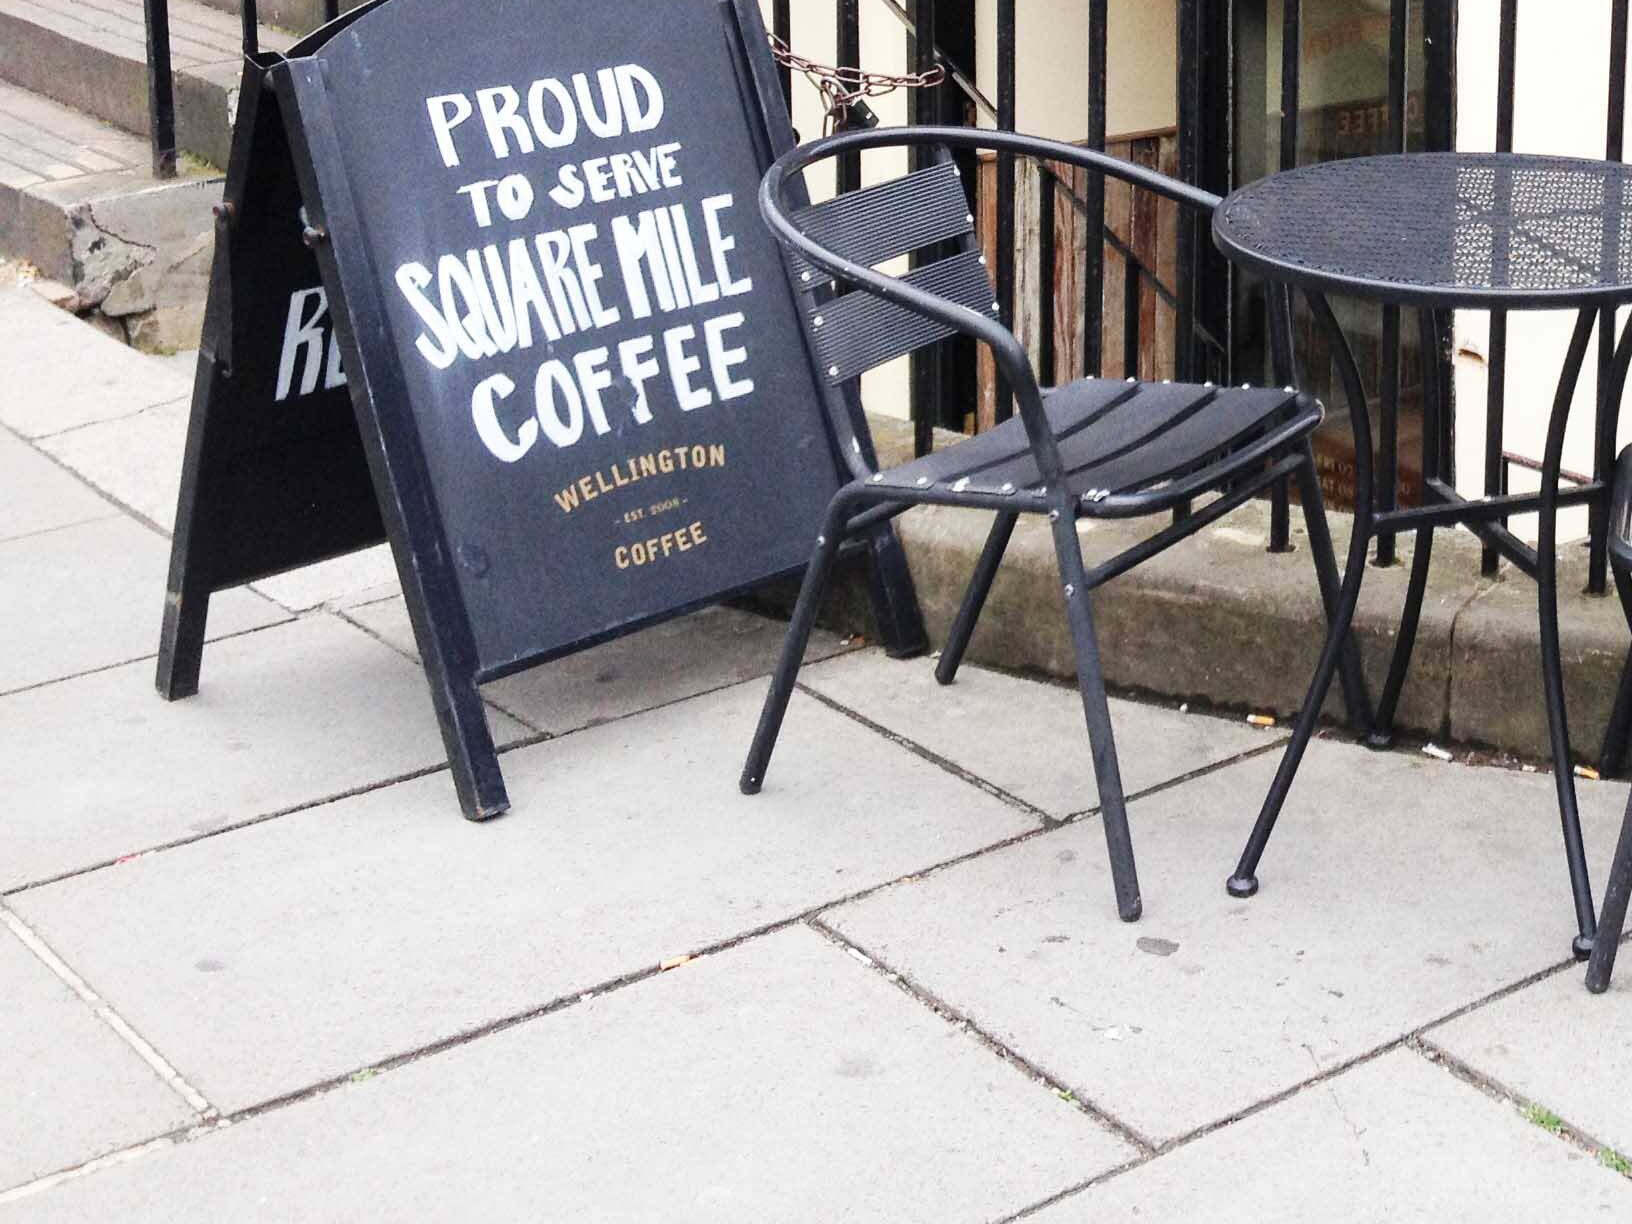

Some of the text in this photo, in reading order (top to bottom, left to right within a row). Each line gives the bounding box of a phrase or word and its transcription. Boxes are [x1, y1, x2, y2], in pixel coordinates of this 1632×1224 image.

[426, 63, 665, 167] PROUD
[457, 143, 683, 227] TO SERVE
[395, 194, 752, 370] SQUARE MILE
[471, 312, 754, 463] COFFEE
[554, 445, 725, 513] WELLINGTON
[614, 521, 707, 569] COFFEE
